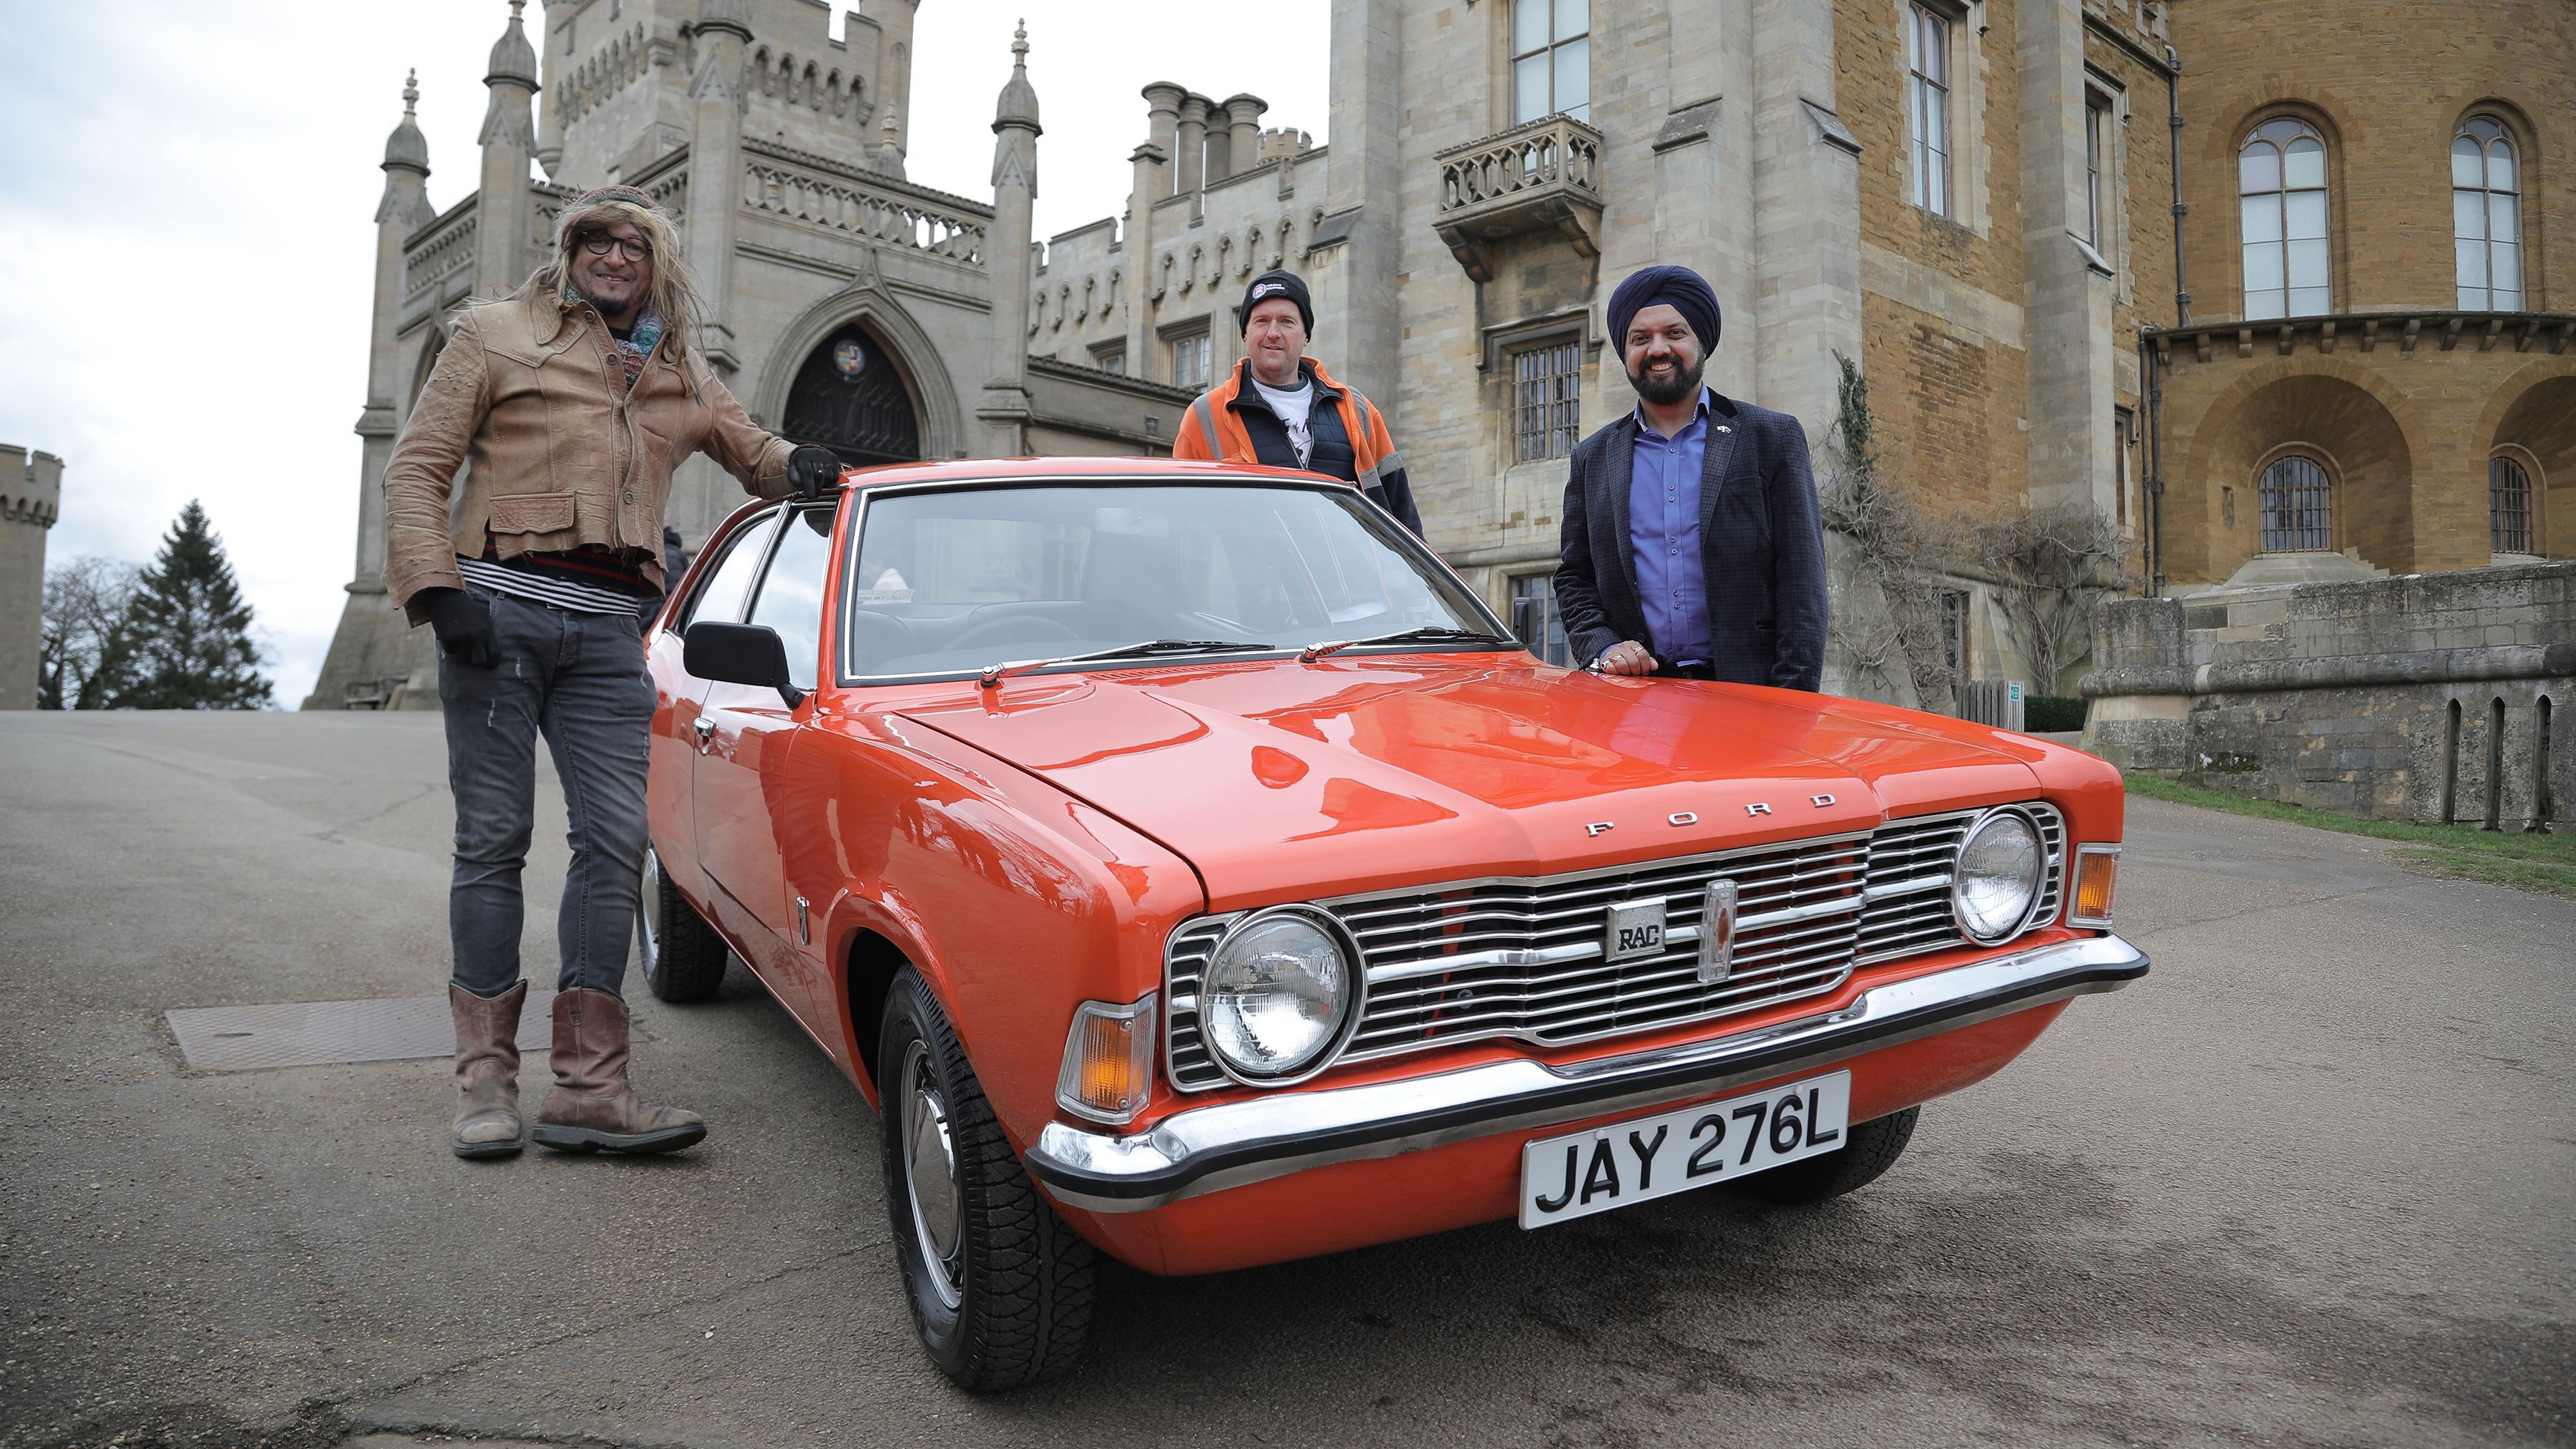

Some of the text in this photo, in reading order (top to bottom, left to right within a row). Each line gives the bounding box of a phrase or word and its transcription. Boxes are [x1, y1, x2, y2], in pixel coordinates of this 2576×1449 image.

[1584, 794, 1836, 837] FORD
[1619, 924, 1659, 951] RAC
[1535, 1088, 1839, 1213] JAY 276L
